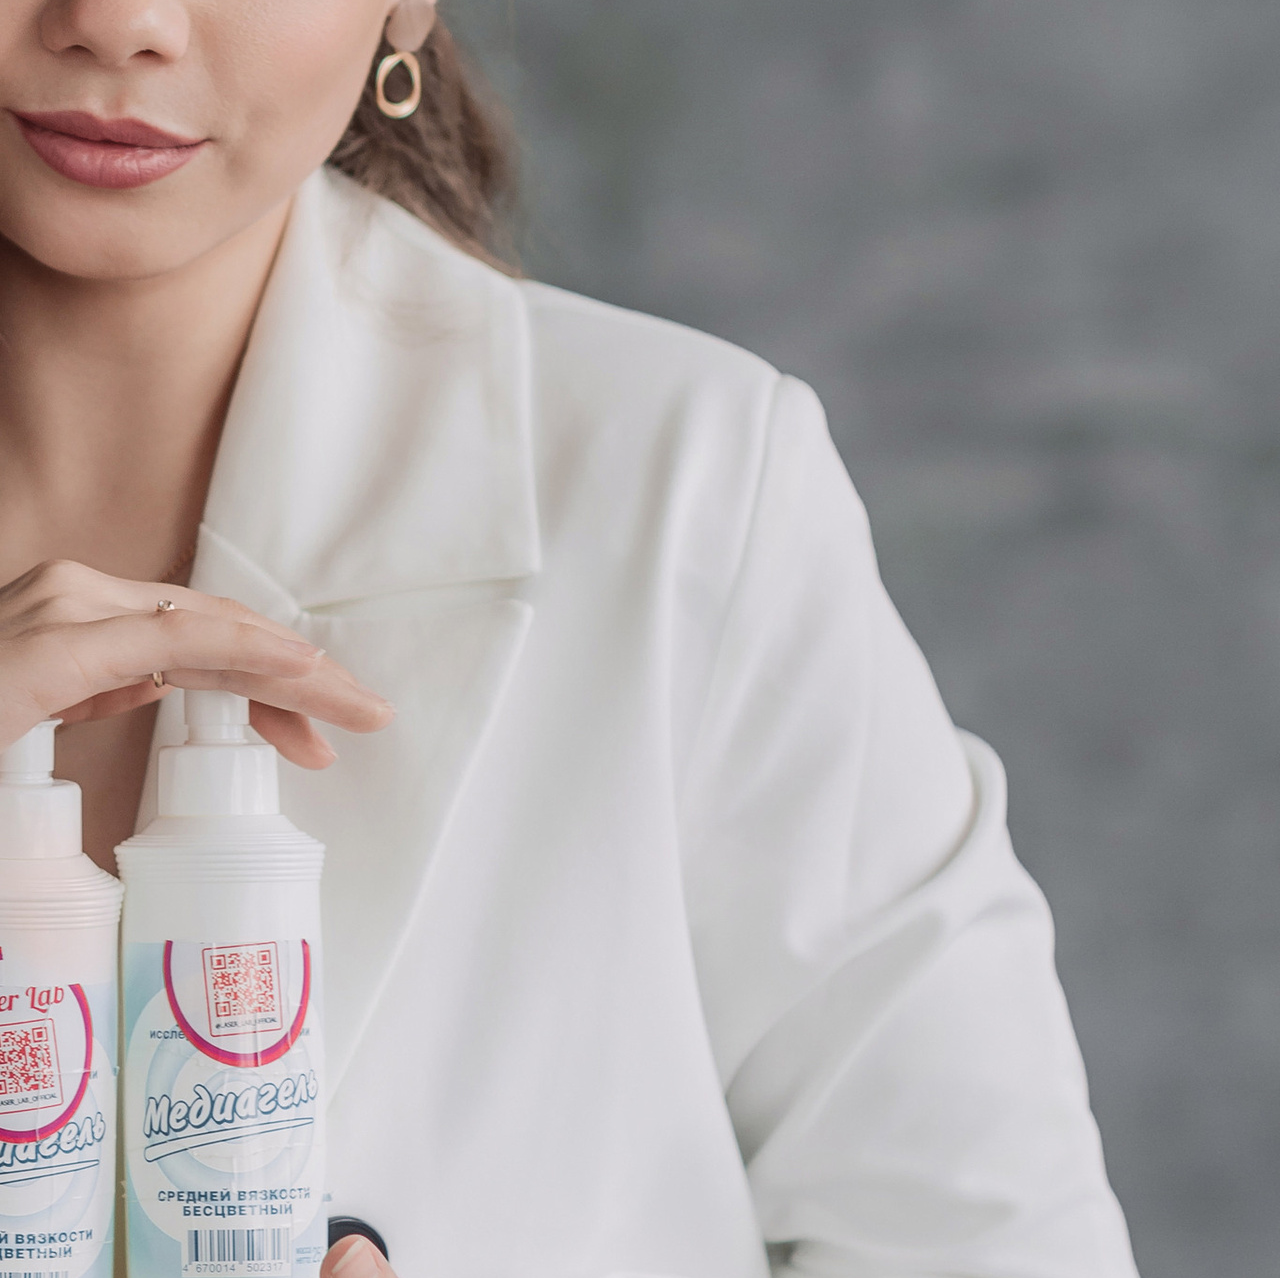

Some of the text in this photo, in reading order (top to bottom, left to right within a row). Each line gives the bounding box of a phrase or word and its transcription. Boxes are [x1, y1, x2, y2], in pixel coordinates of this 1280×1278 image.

[25, 986, 64, 1014] Lab
[142, 1068, 319, 1139] Медиагель
[158, 1187, 231, 1204] СРЕДНЕЙ
[237, 1186, 311, 1202] ВЯЗКОСТИ
[182, 1202, 293, 1219] БЕСЦВЕТНЫЙ
[14, 1228, 93, 1245] ВЯЗКОСТИ
[182, 1262, 283, 1273] 4 670014 502317
